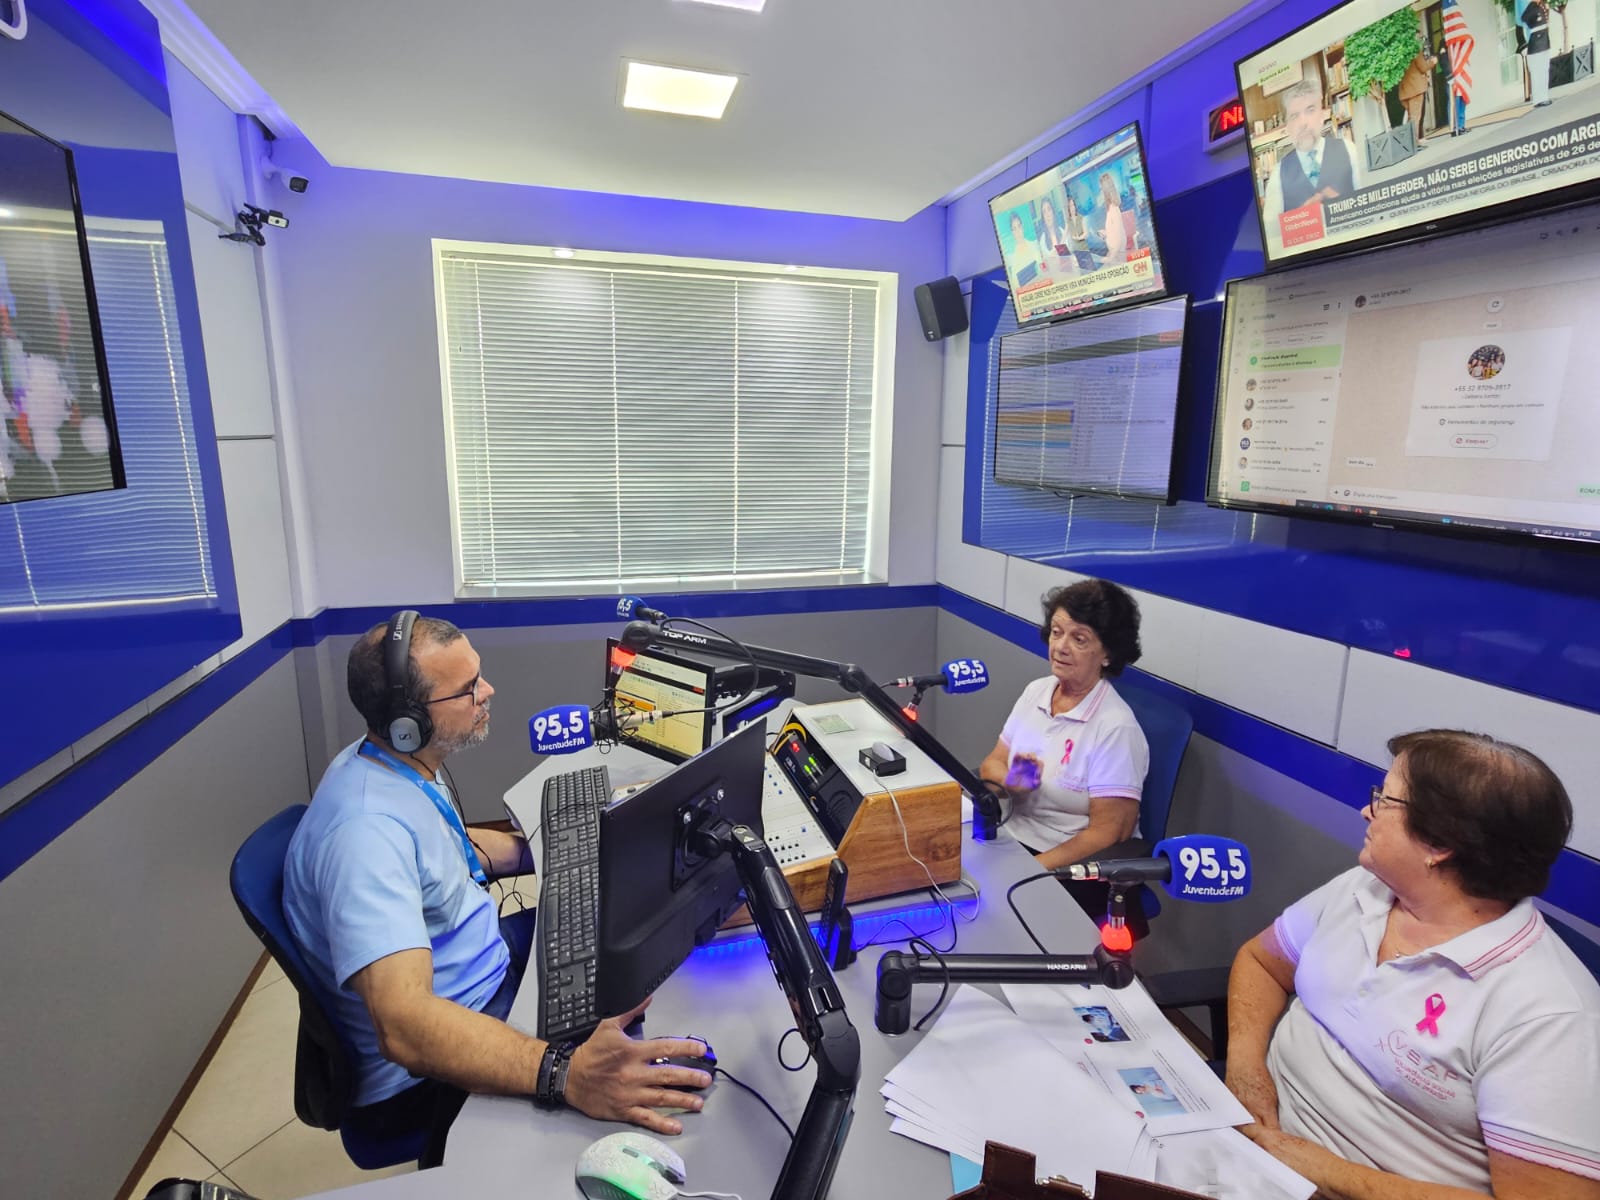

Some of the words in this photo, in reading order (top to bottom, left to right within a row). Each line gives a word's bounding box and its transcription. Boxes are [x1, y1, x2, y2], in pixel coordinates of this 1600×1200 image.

[1328, 199, 1356, 214] TRUMP:
[1356, 195, 1368, 206] SE
[1368, 187, 1390, 203] MILEI
[1390, 177, 1426, 197] PERDER,
[1427, 167, 1448, 185] NÃO
[1449, 162, 1476, 179] SEREI
[1478, 142, 1537, 170] GENEROSO
[1539, 132, 1568, 152] COM
[1330, 210, 1362, 223] Americano
[1363, 200, 1399, 214] condiciona
[1400, 194, 1419, 205] ajuda
[1426, 184, 1450, 196] vitória
[1451, 180, 1466, 189] nas
[1467, 170, 1502, 185] eleições
[1504, 156, 1553, 176] legislativas
[1556, 148, 1569, 159] de
[1572, 144, 1585, 155] 26
[1133, 260, 1148, 274] CNN
[662, 630, 683, 639] TOP
[684, 635, 706, 645] ARM
[948, 659, 984, 679] 95,5
[534, 711, 583, 741] 95,5
[1179, 847, 1246, 885] 95,5
[1182, 884, 1244, 896] JuventudeFM
